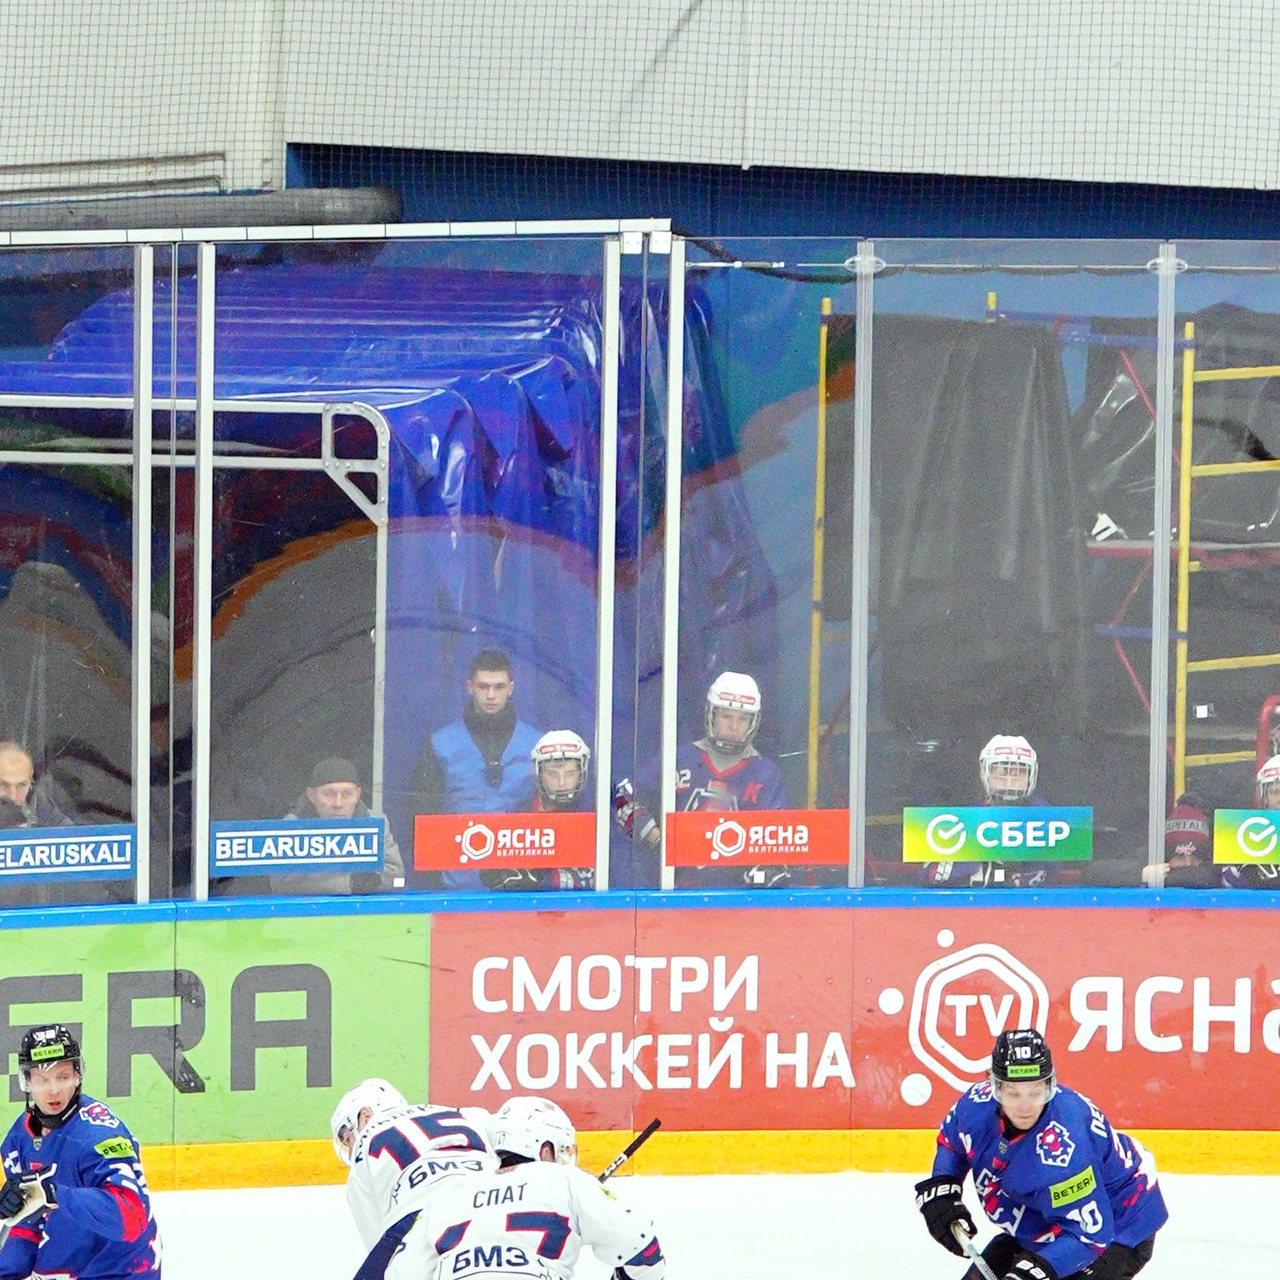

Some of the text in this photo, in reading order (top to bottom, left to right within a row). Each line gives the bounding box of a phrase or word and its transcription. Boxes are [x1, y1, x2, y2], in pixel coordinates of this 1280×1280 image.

[215, 833, 379, 860] BELARUSKALI
[976, 821, 1071, 848] СБЕР
[471, 954, 759, 1013] СМОТРИ
[945, 994, 1014, 1037] TV
[470, 1016, 857, 1091] ХОККЕЙ НА
[1014, 1046, 1031, 1059] 10
[369, 1109, 487, 1171] 15
[408, 1160, 484, 1189] БМЗ
[473, 1182, 528, 1209] СПАТ
[916, 1183, 962, 1209] AUER
[452, 1245, 530, 1272] БМЗ
